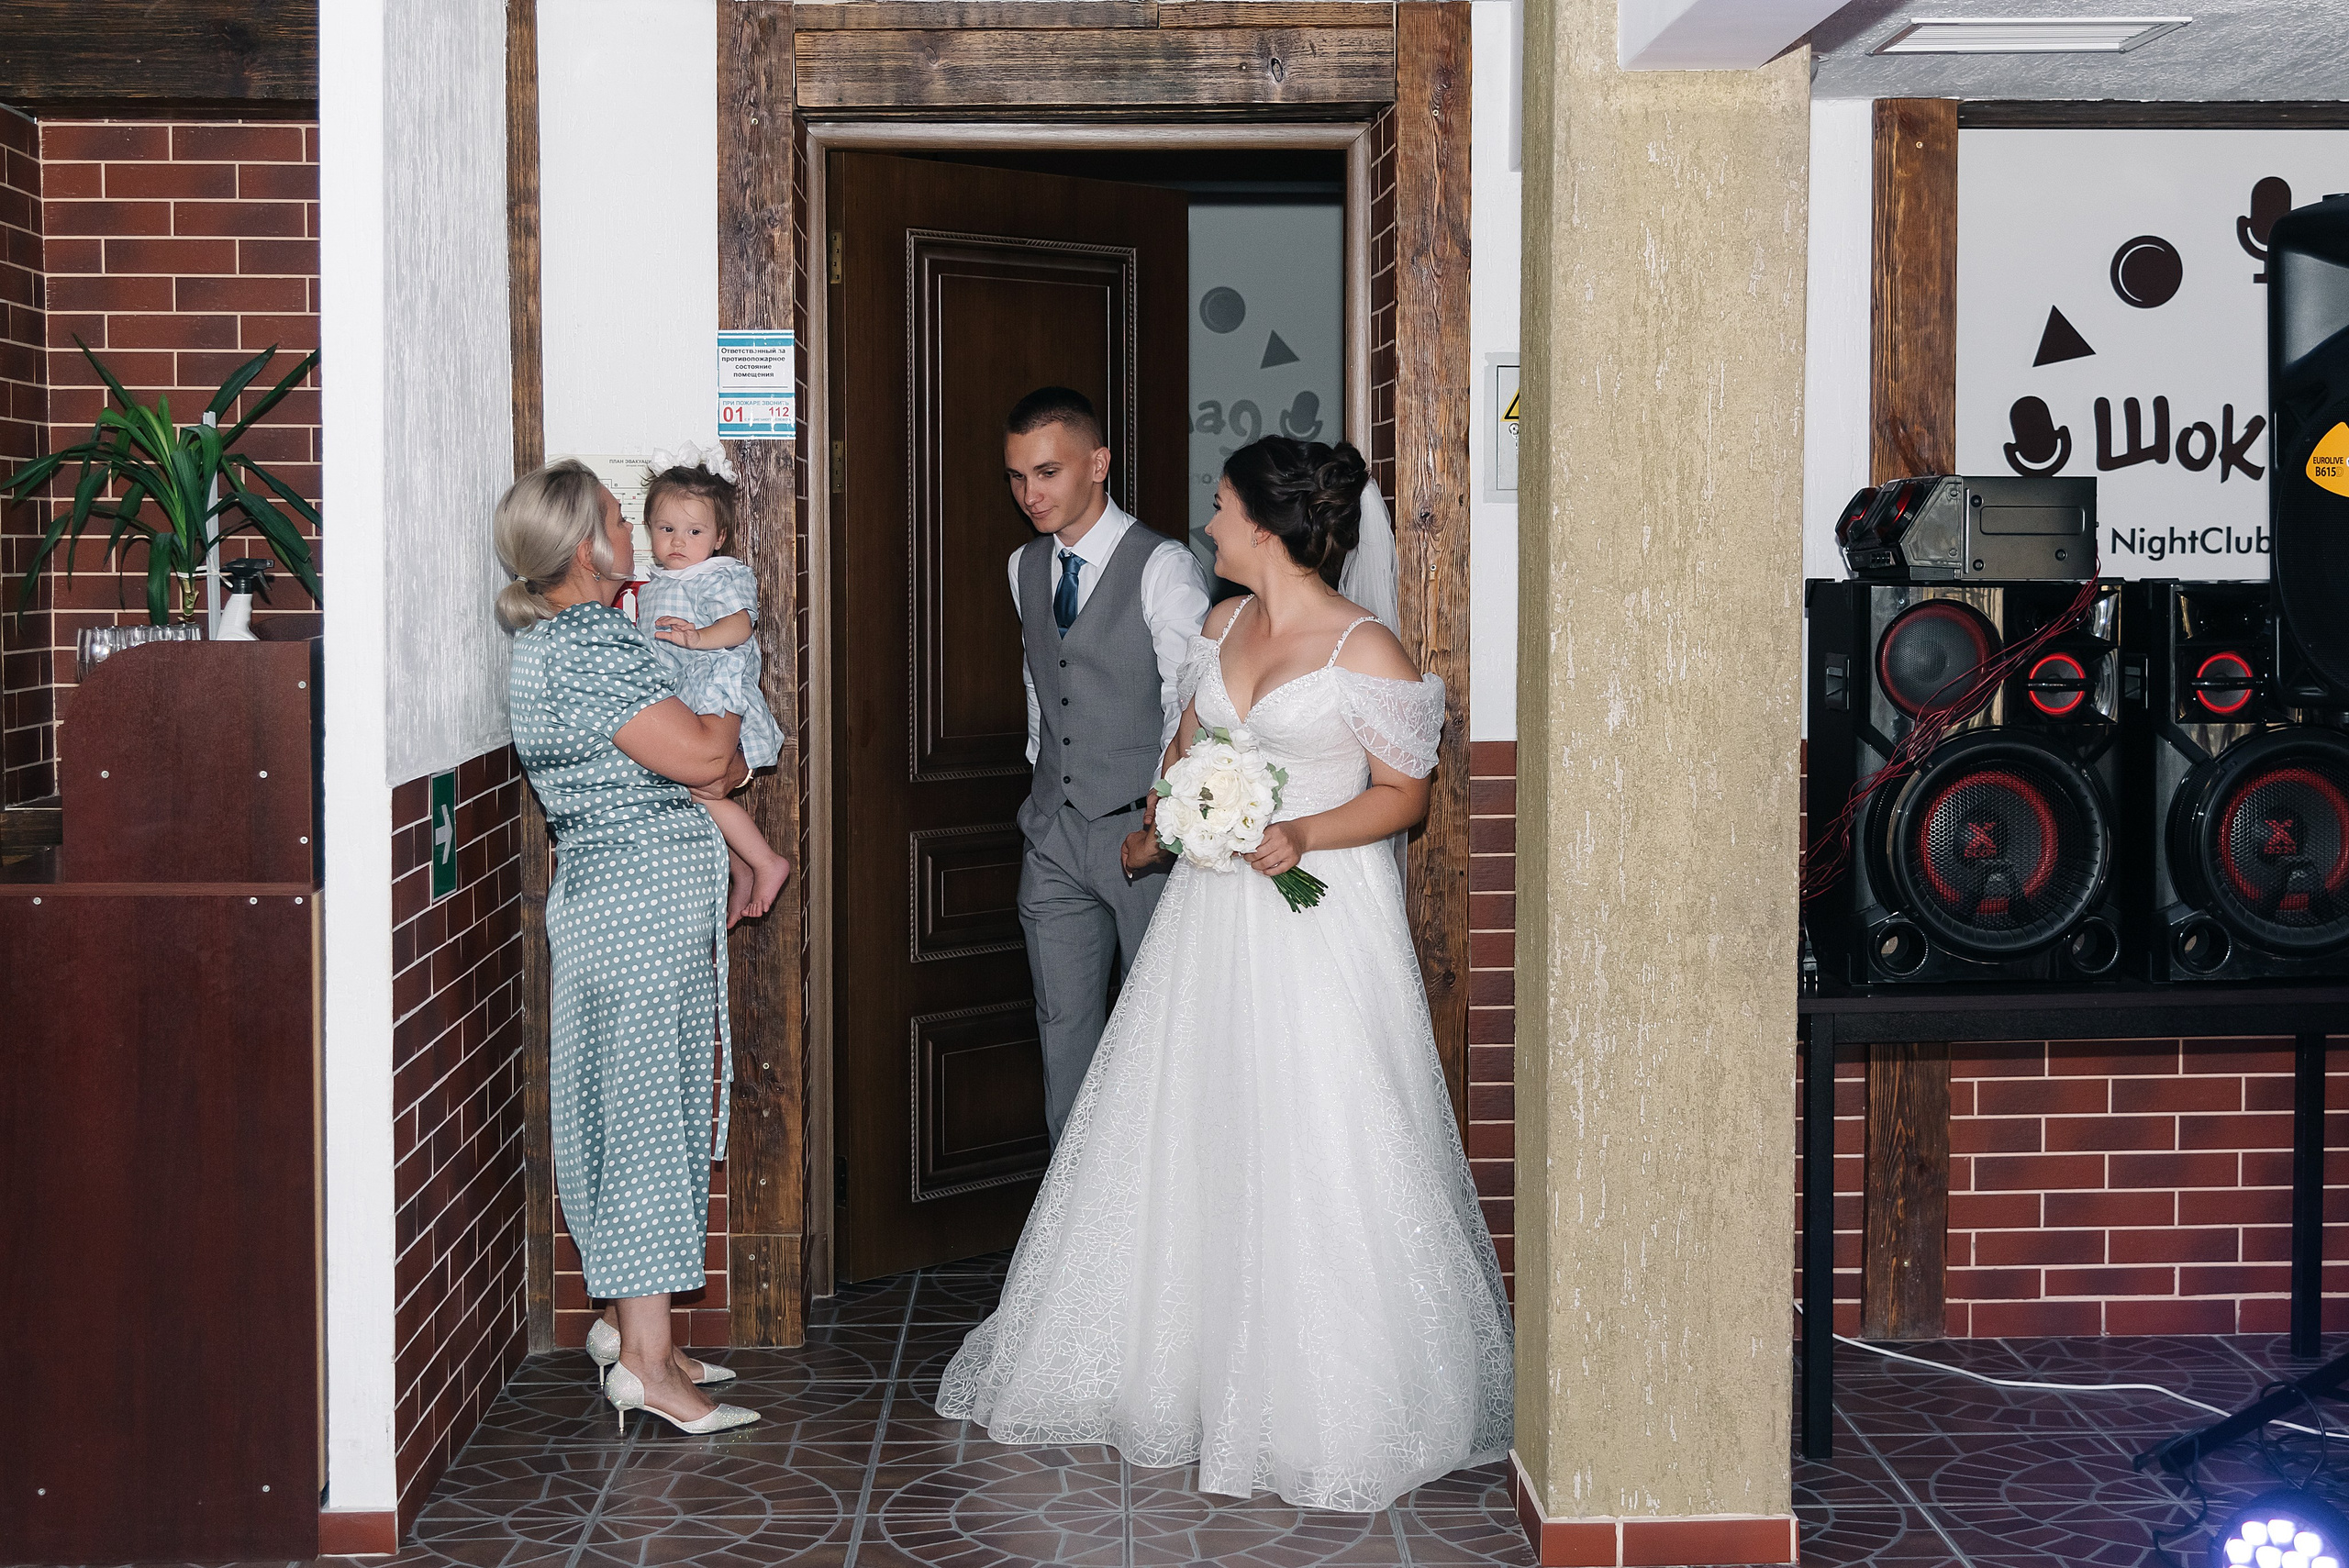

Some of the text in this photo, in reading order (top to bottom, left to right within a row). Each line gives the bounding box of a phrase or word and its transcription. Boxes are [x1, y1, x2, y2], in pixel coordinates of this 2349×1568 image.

[723, 406, 789, 422] 01 112
[2315, 466, 2344, 477] B615D
[2111, 526, 2271, 562] NightClub
